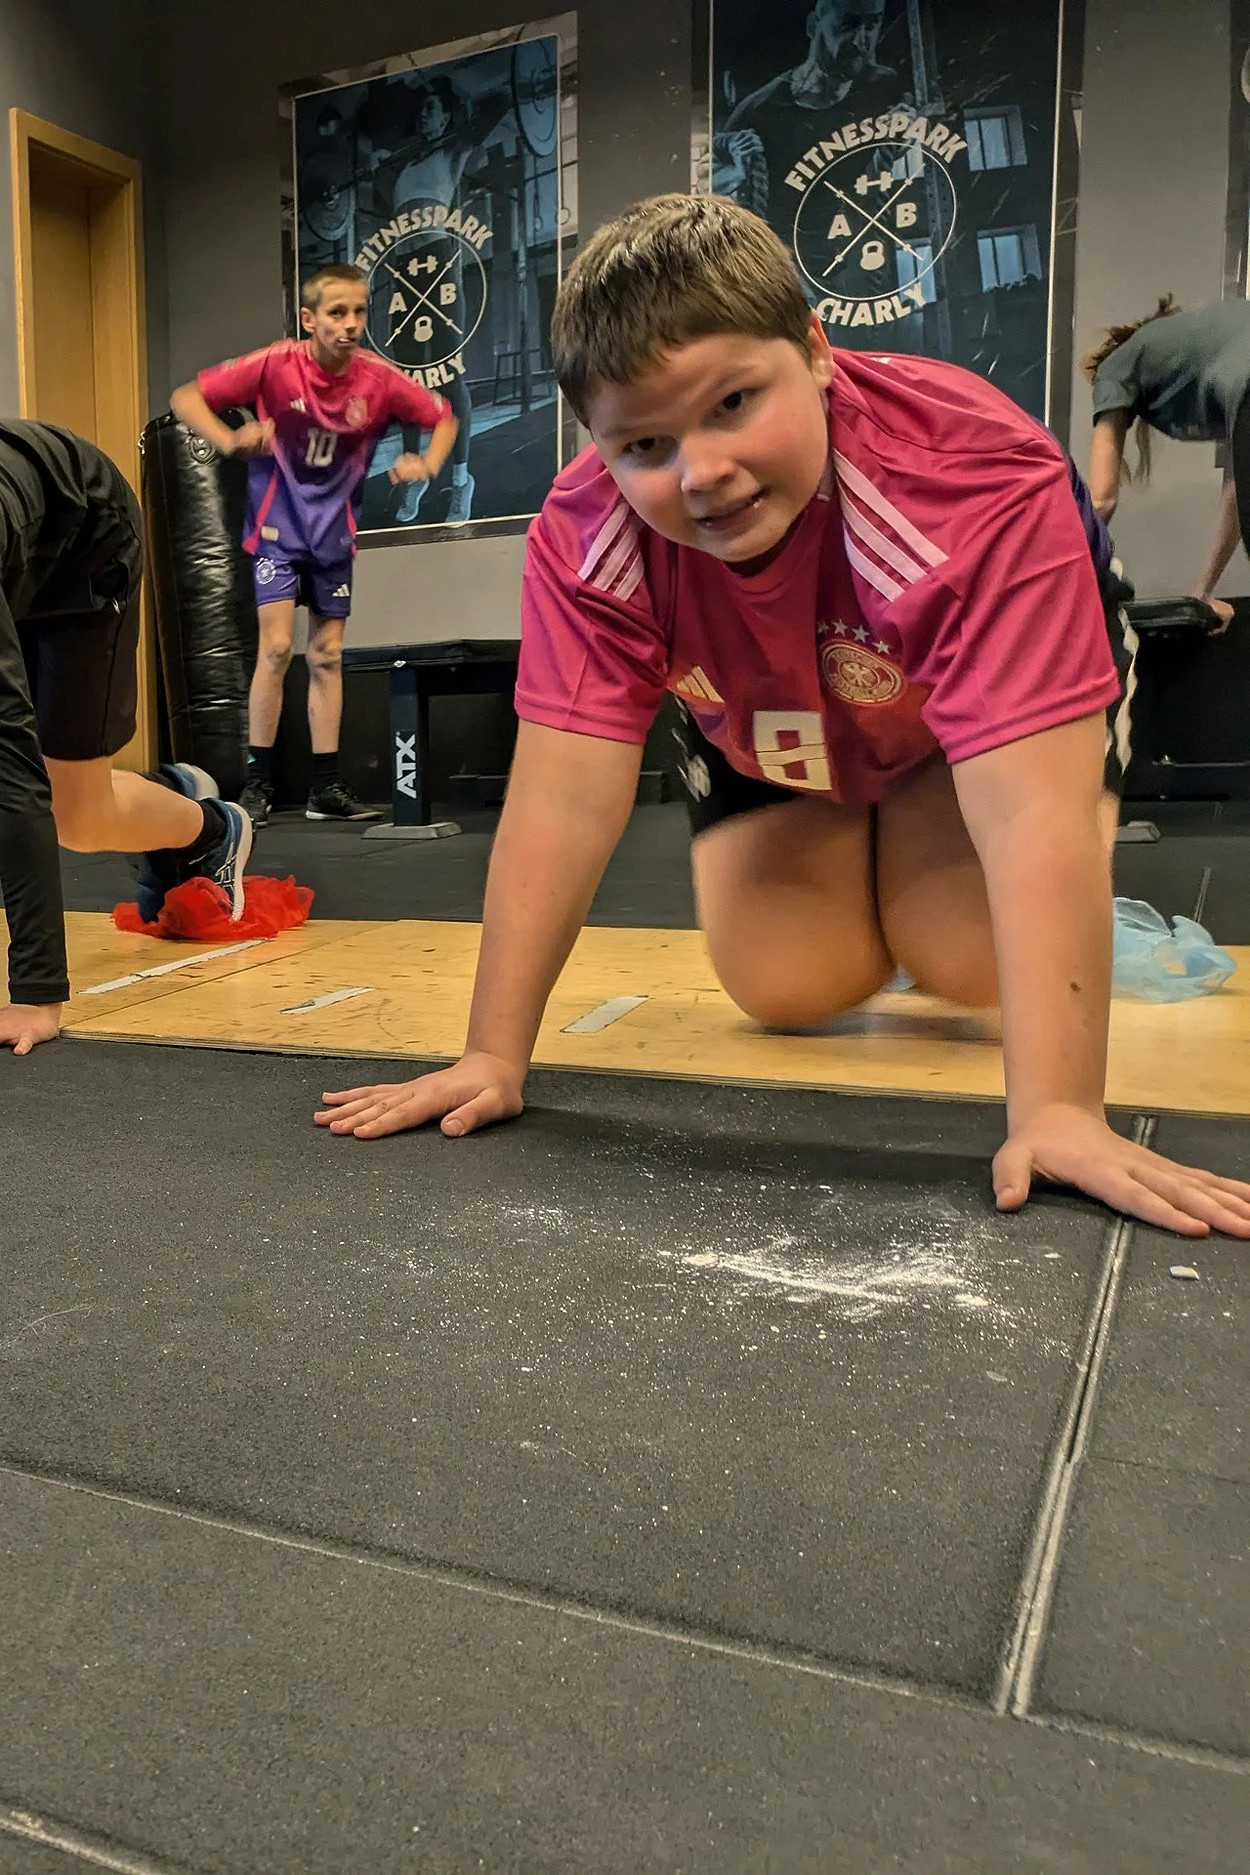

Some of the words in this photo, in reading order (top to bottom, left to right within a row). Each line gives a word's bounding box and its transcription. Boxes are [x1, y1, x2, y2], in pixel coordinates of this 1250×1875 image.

[784, 112, 968, 192] FITNESSPARK
[354, 205, 493, 272] FITNESSPARK
[827, 214, 852, 240] A
[896, 202, 917, 228] B
[388, 292, 408, 315] A
[440, 282, 457, 306] B
[816, 283, 927, 327] CHARLY
[402, 352, 467, 389] ARLY
[305, 428, 338, 468] 10
[395, 734, 417, 799] ATX
[753, 710, 833, 791] 8
